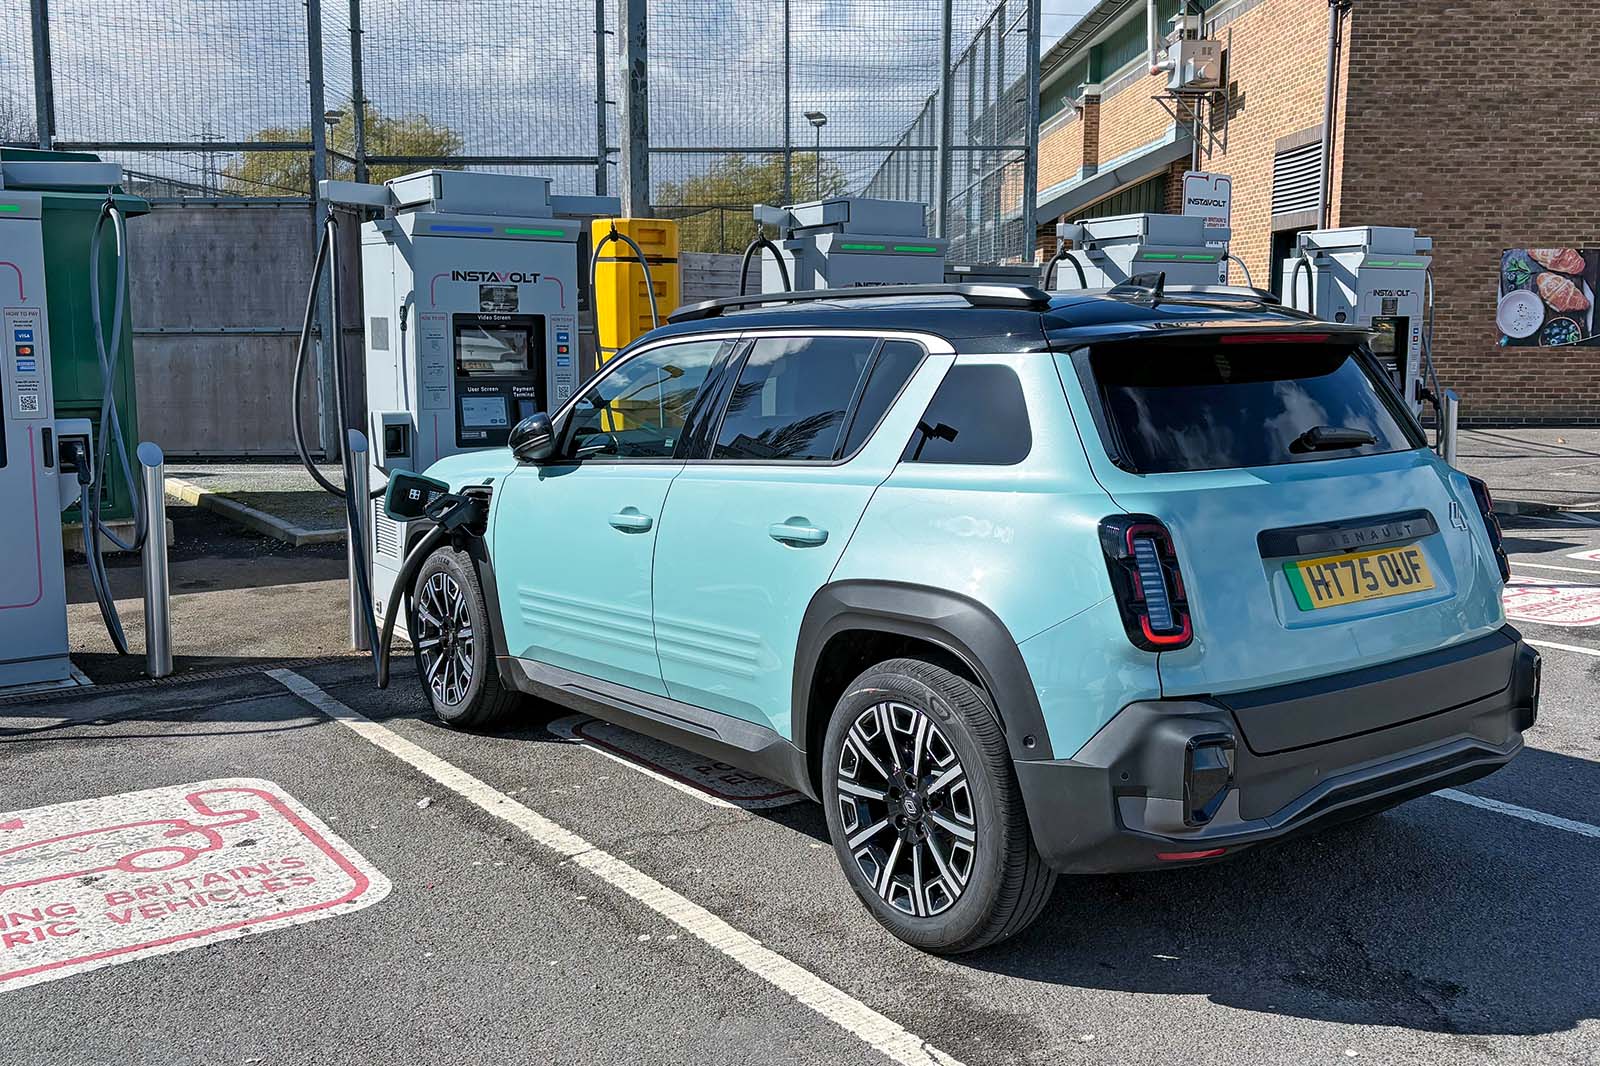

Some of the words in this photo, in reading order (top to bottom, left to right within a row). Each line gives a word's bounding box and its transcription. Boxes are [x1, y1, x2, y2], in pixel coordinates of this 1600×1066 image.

[1187, 197, 1227, 208] INSTAVOLT
[452, 270, 541, 284] INSTAVOLT
[1373, 289, 1410, 297] INSTAVOLT
[1306, 557, 1379, 600] HT75
[1377, 550, 1421, 588] OUF
[104, 857, 305, 906] BRITAIN'S
[2, 921, 80, 949] RIC
[106, 877, 316, 924] VEHICLES
